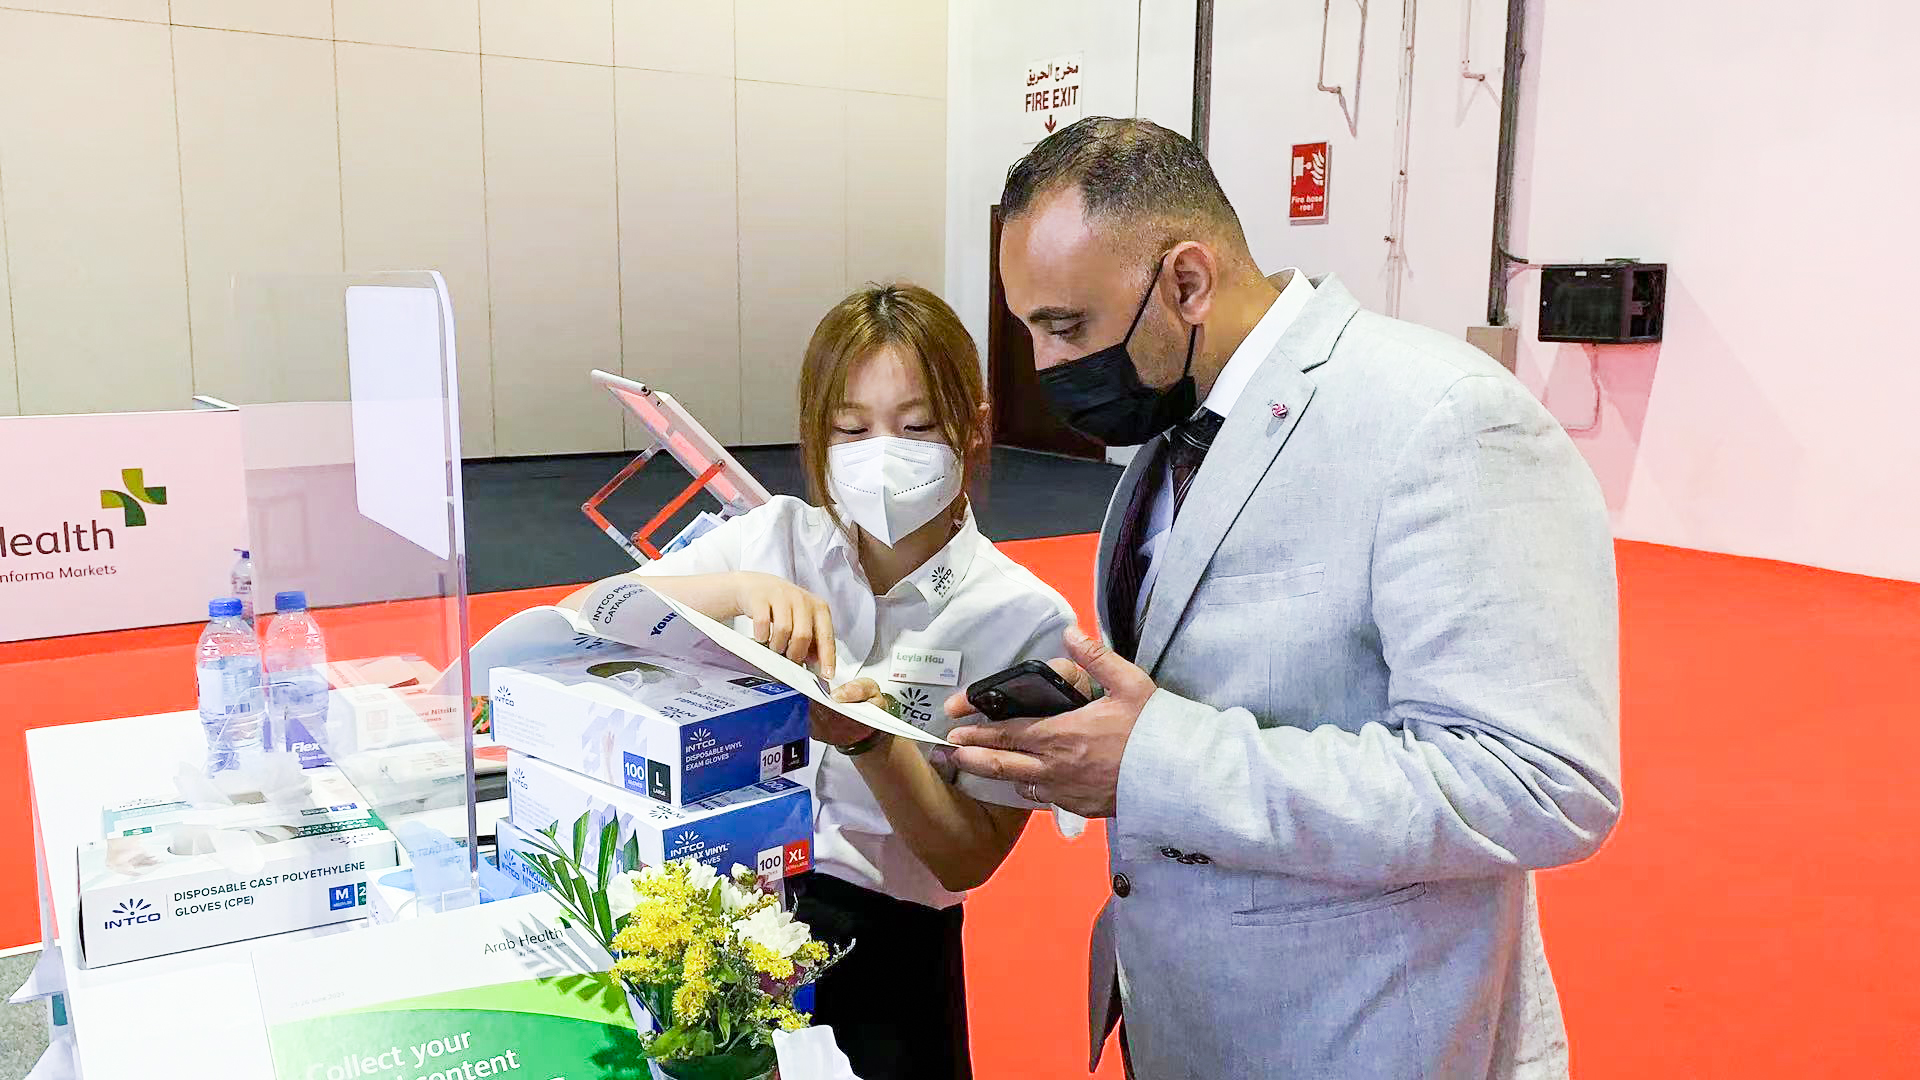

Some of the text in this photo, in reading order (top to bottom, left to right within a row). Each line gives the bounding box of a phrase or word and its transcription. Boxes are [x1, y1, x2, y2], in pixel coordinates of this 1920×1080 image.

[1026, 62, 1079, 87] مخرج الحريق
[1025, 85, 1079, 113] FIRE EXIT
[0, 520, 114, 558] ealth
[0, 565, 117, 583] nforma Markets
[933, 569, 953, 593] INTCO
[592, 593, 615, 622] INTCO
[650, 611, 678, 637] Your
[494, 695, 515, 707] INTCO
[901, 703, 932, 722] TCO
[292, 742, 321, 753] Flex
[685, 738, 716, 754] INTCO
[685, 741, 743, 764] DISPOSABLE VINYL
[791, 746, 799, 759] L
[685, 752, 730, 772] EXAM GLOVES
[761, 751, 781, 767] 100
[624, 762, 645, 781] 100
[655, 771, 664, 788] L
[670, 841, 705, 858] INTCO
[788, 848, 806, 864] XL
[759, 855, 782, 871] 100
[174, 861, 366, 902] DISPOSABLE CAST POLYETHYLENE
[335, 887, 349, 900] M
[175, 895, 254, 917] GLOVES (CPE)
[104, 912, 161, 930] INTCO
[484, 937, 516, 955] Arab
[518, 927, 564, 947] Health
[306, 1031, 471, 1080] Collect your
[414, 1049, 521, 1080] ntent
